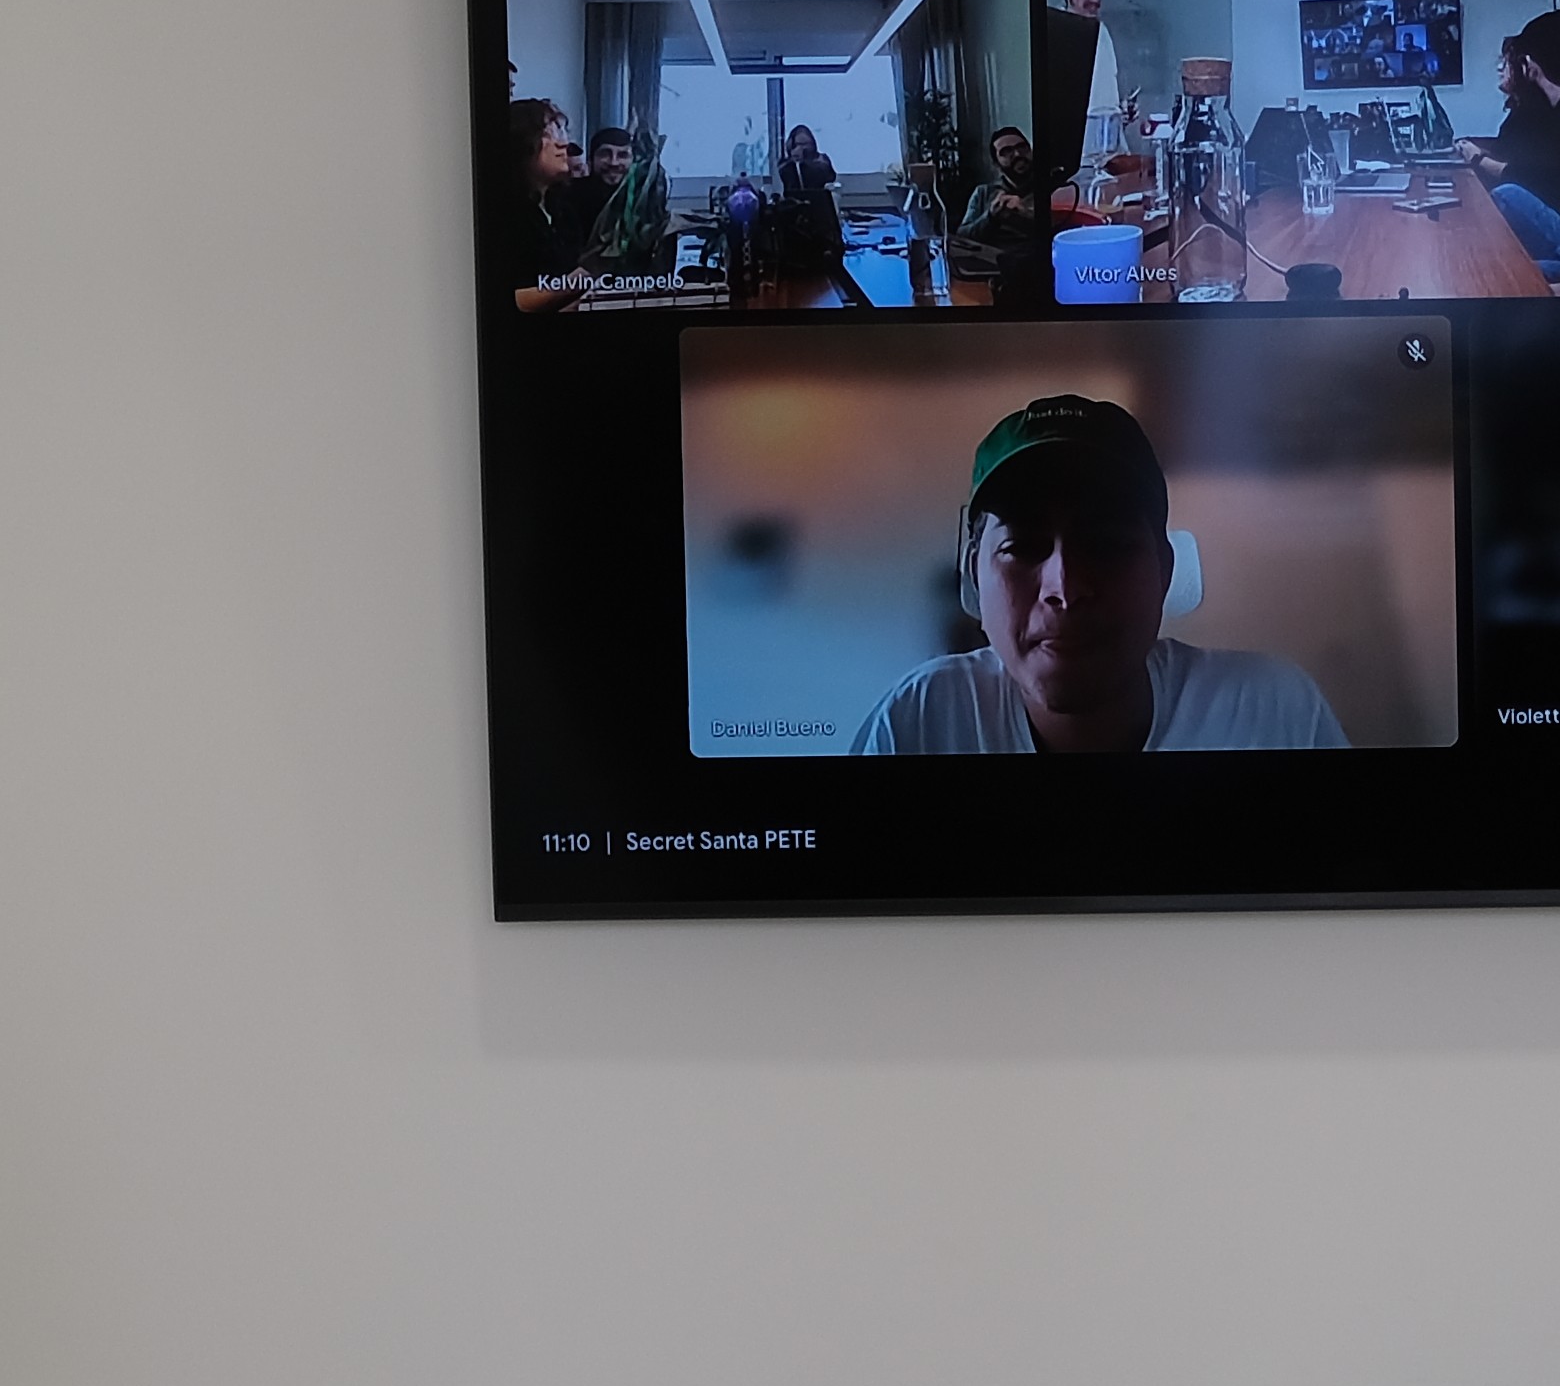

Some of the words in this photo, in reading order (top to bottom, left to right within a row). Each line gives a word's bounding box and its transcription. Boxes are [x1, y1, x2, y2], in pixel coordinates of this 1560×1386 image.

[538, 274, 594, 291] Kelvin
[600, 272, 684, 292] Campelo
[1075, 266, 1121, 282] Vitor
[1126, 265, 1177, 282] Alves
[711, 719, 771, 737] Daniel
[775, 719, 836, 737] Bueno
[541, 832, 591, 852] 11:10
[625, 831, 695, 851] Secret
[699, 830, 759, 850] Santa
[764, 828, 817, 849] PETE
